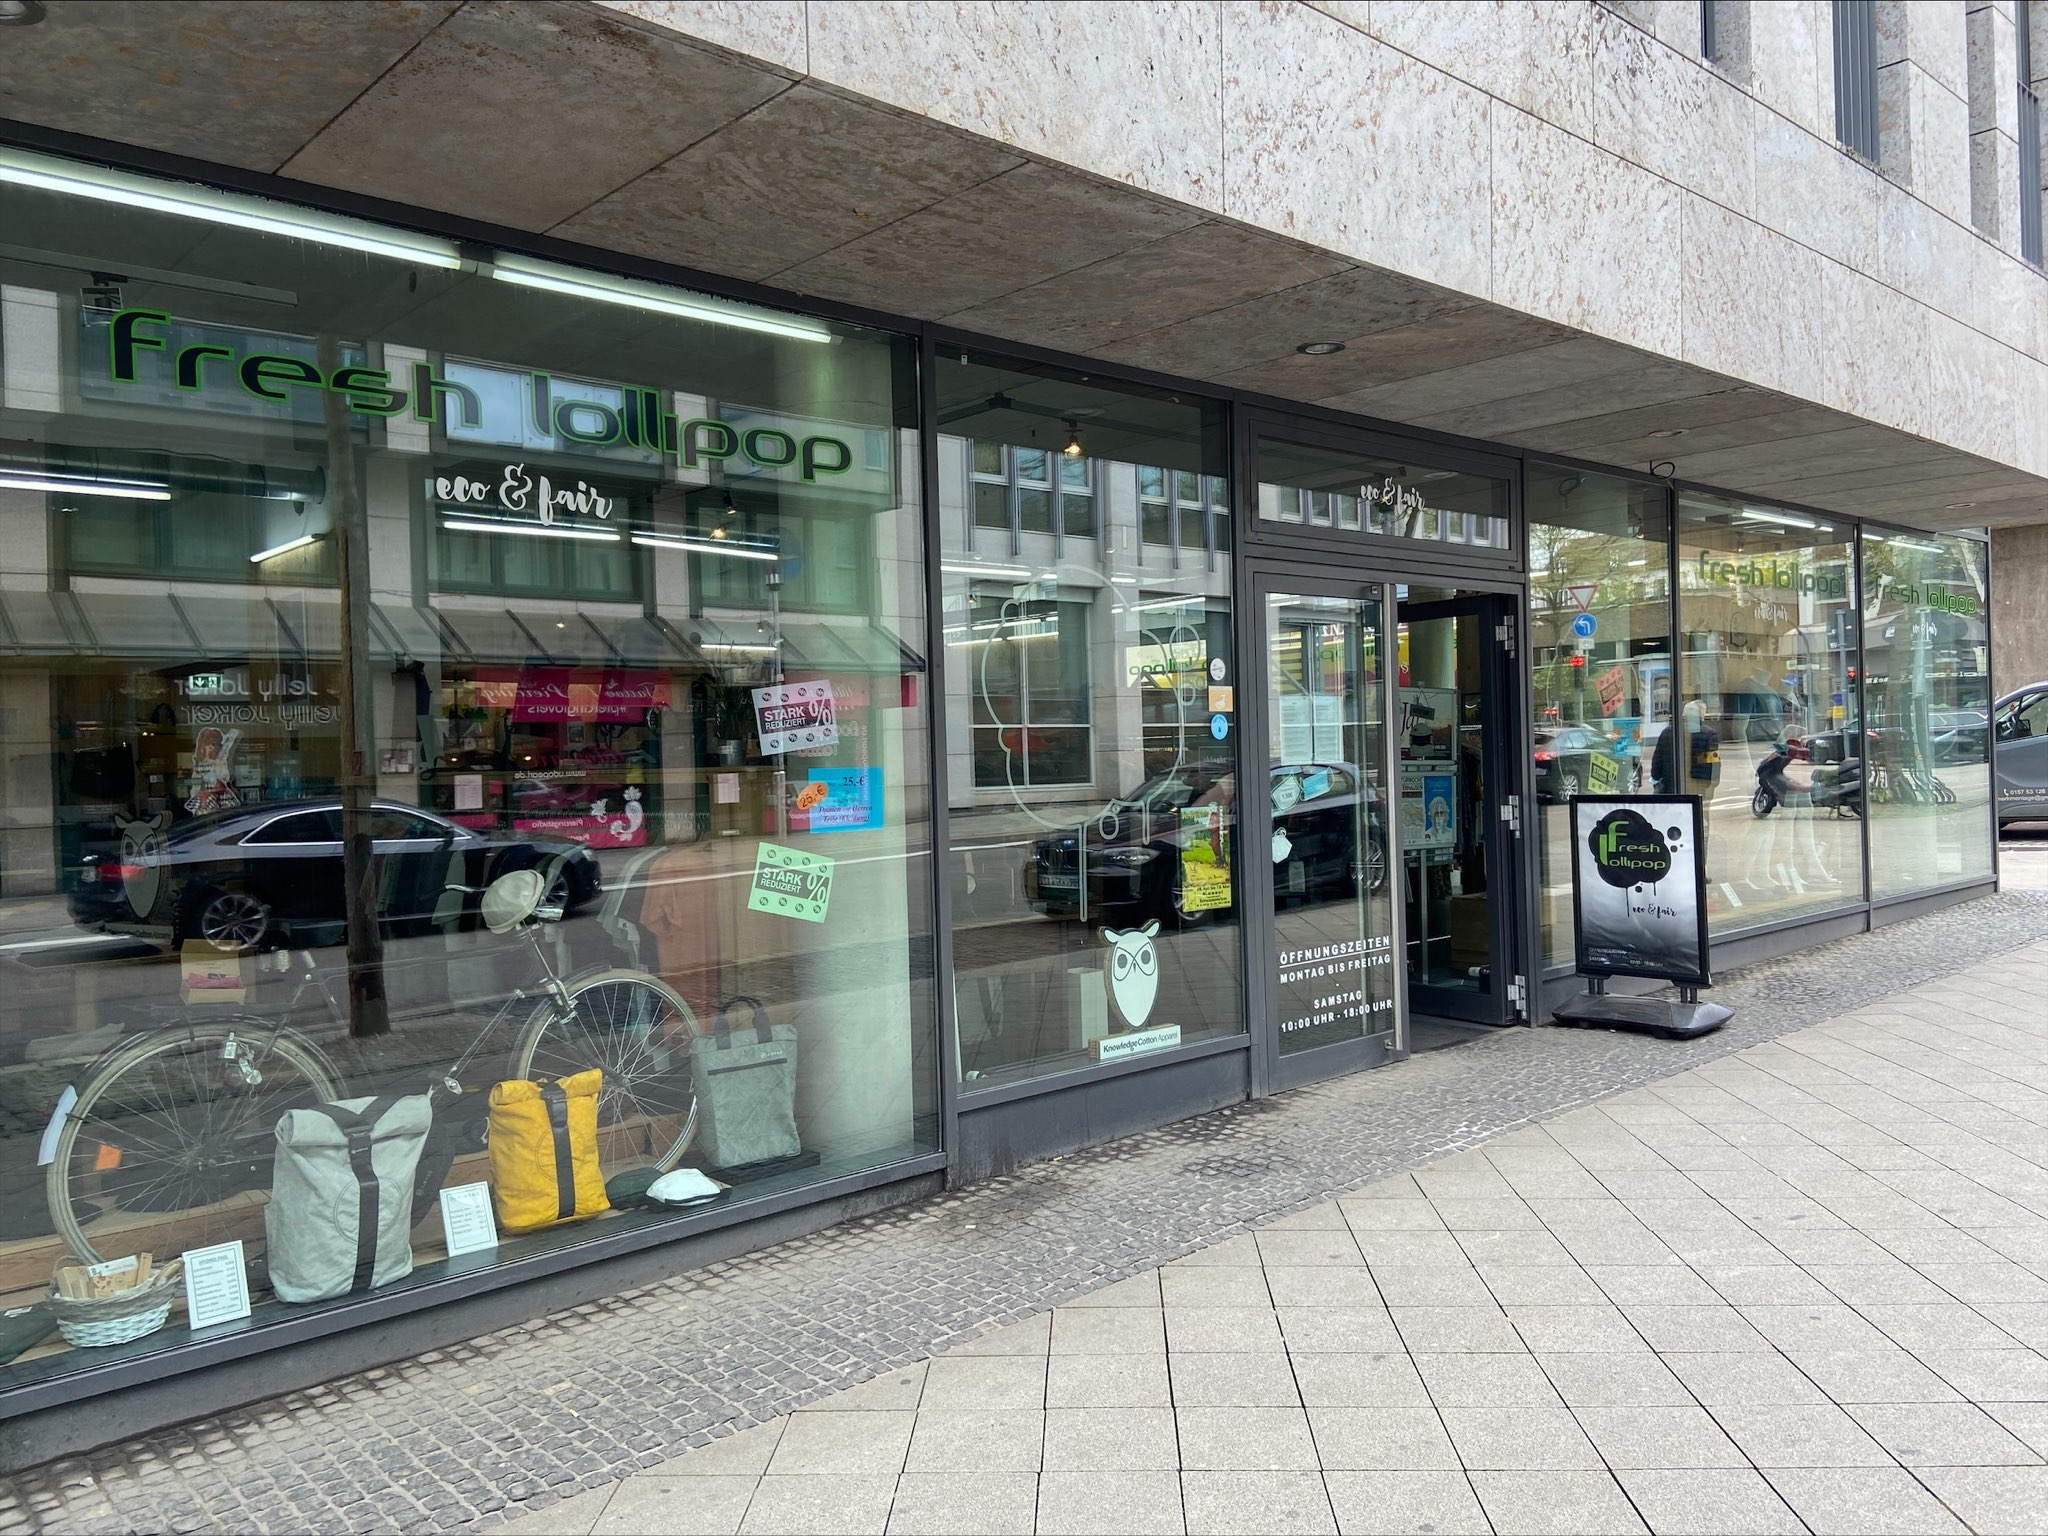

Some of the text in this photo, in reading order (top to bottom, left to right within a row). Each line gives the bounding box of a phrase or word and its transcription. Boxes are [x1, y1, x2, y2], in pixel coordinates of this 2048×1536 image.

[109, 308, 853, 483] fresh lollipop
[436, 463, 613, 527] eco & fair
[1699, 550, 1842, 598] fresh lollipop
[1875, 575, 1977, 615] fresh lollipop
[764, 706, 806, 722] STARK
[764, 717, 807, 731] REDUZIERT
[760, 878, 802, 894] REDUZIERT
[763, 867, 803, 886] STARK
[1279, 935, 1390, 966] ÖFFNUNGSZEITEN
[1279, 954, 1391, 984] MONTAG BIS FREITAG
[1313, 990, 1362, 1009] SAMSTAG
[1281, 1017, 1311, 1033] 10:00
[1313, 1012, 1335, 1025] UHR
[1343, 1004, 1370, 1018] 18:00
[1372, 999, 1393, 1012] UHR
